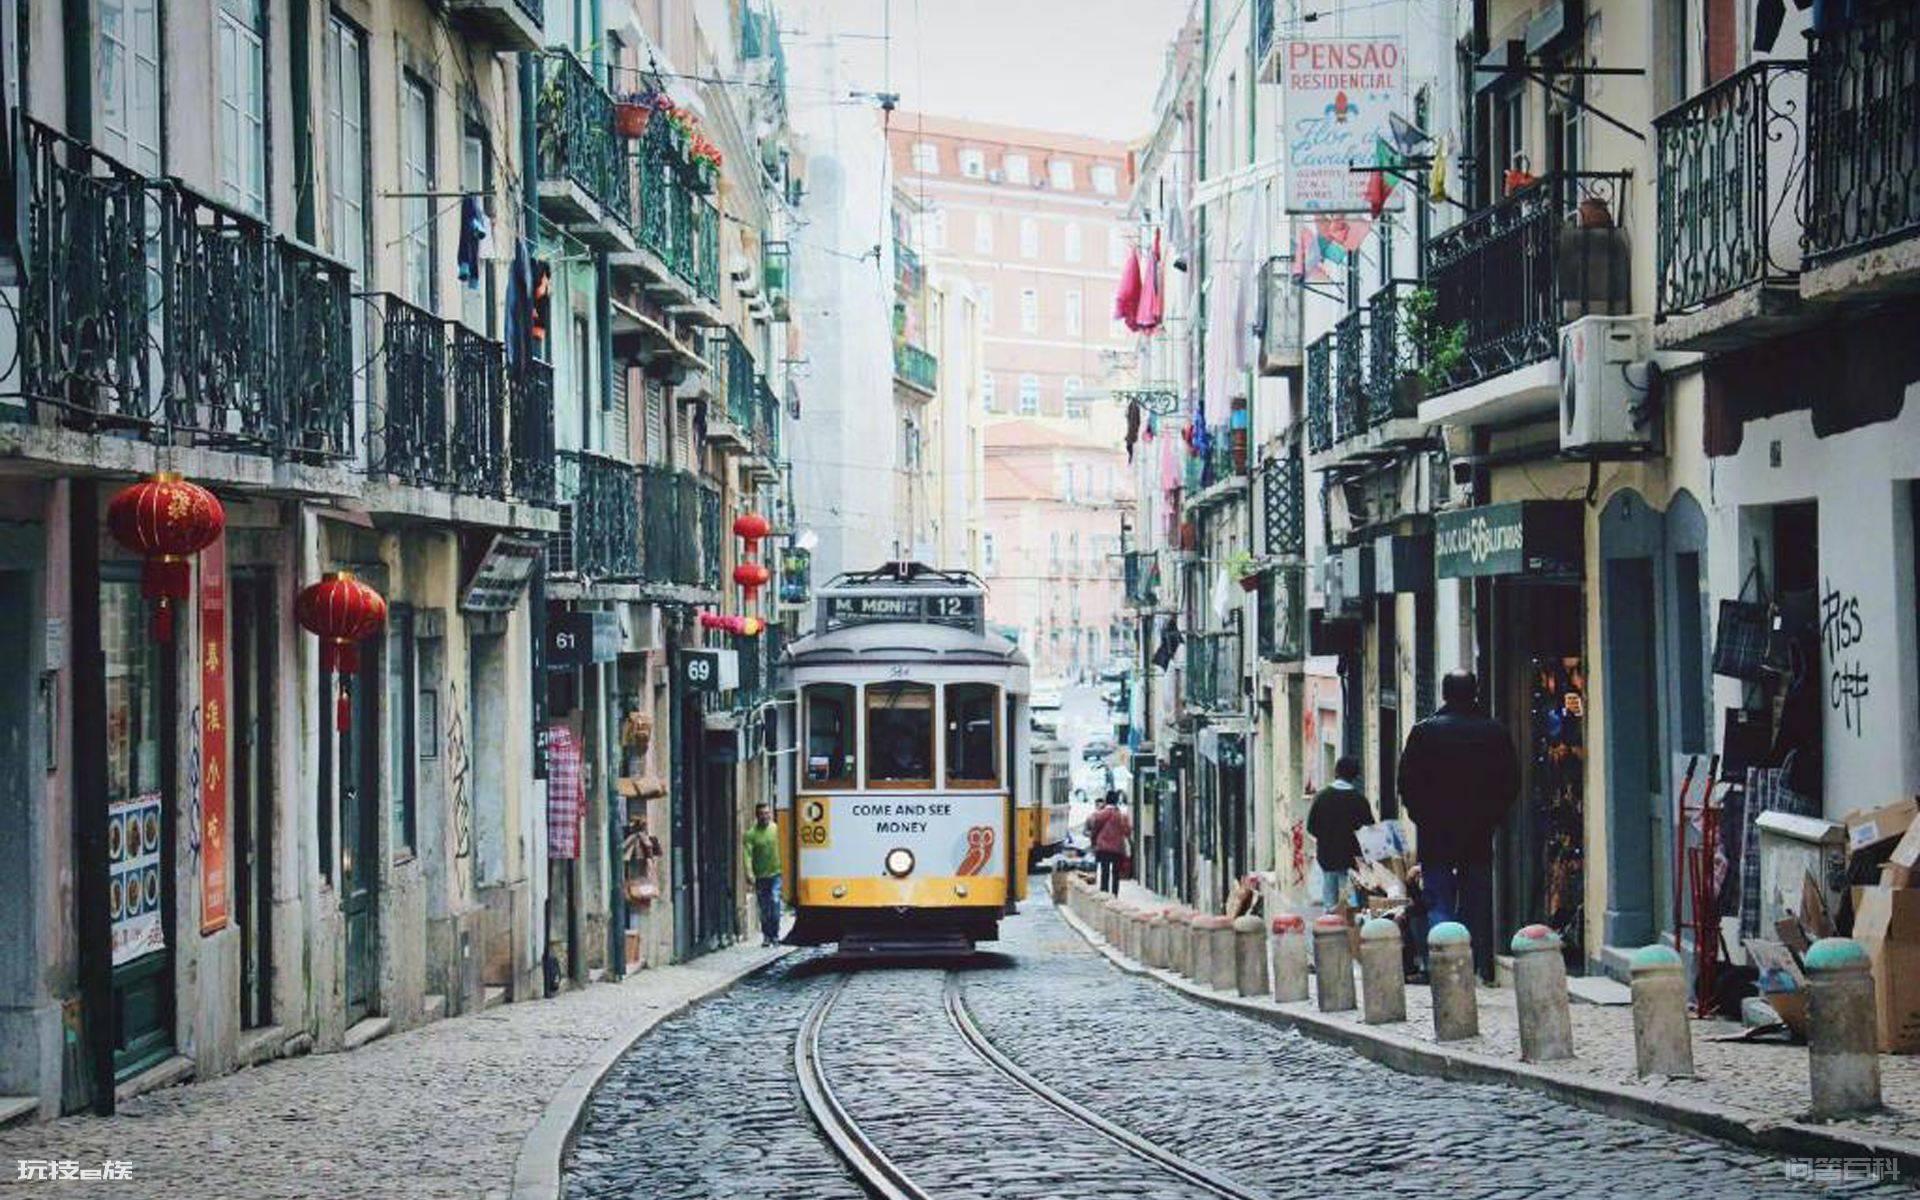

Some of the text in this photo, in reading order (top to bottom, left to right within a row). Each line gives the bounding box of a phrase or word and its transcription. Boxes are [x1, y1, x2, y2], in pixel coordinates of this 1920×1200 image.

[1289, 42, 1398, 70] PENSAO
[1291, 73, 1396, 90] RESIDENCIAL
[1470, 516, 1488, 563] 56
[862, 600, 918, 613] MONIZ
[938, 598, 961, 615] 12
[556, 632, 575, 649] 61
[688, 660, 710, 680] 69
[852, 804, 951, 816] COME AND SEE
[876, 822, 927, 833] MONEY
